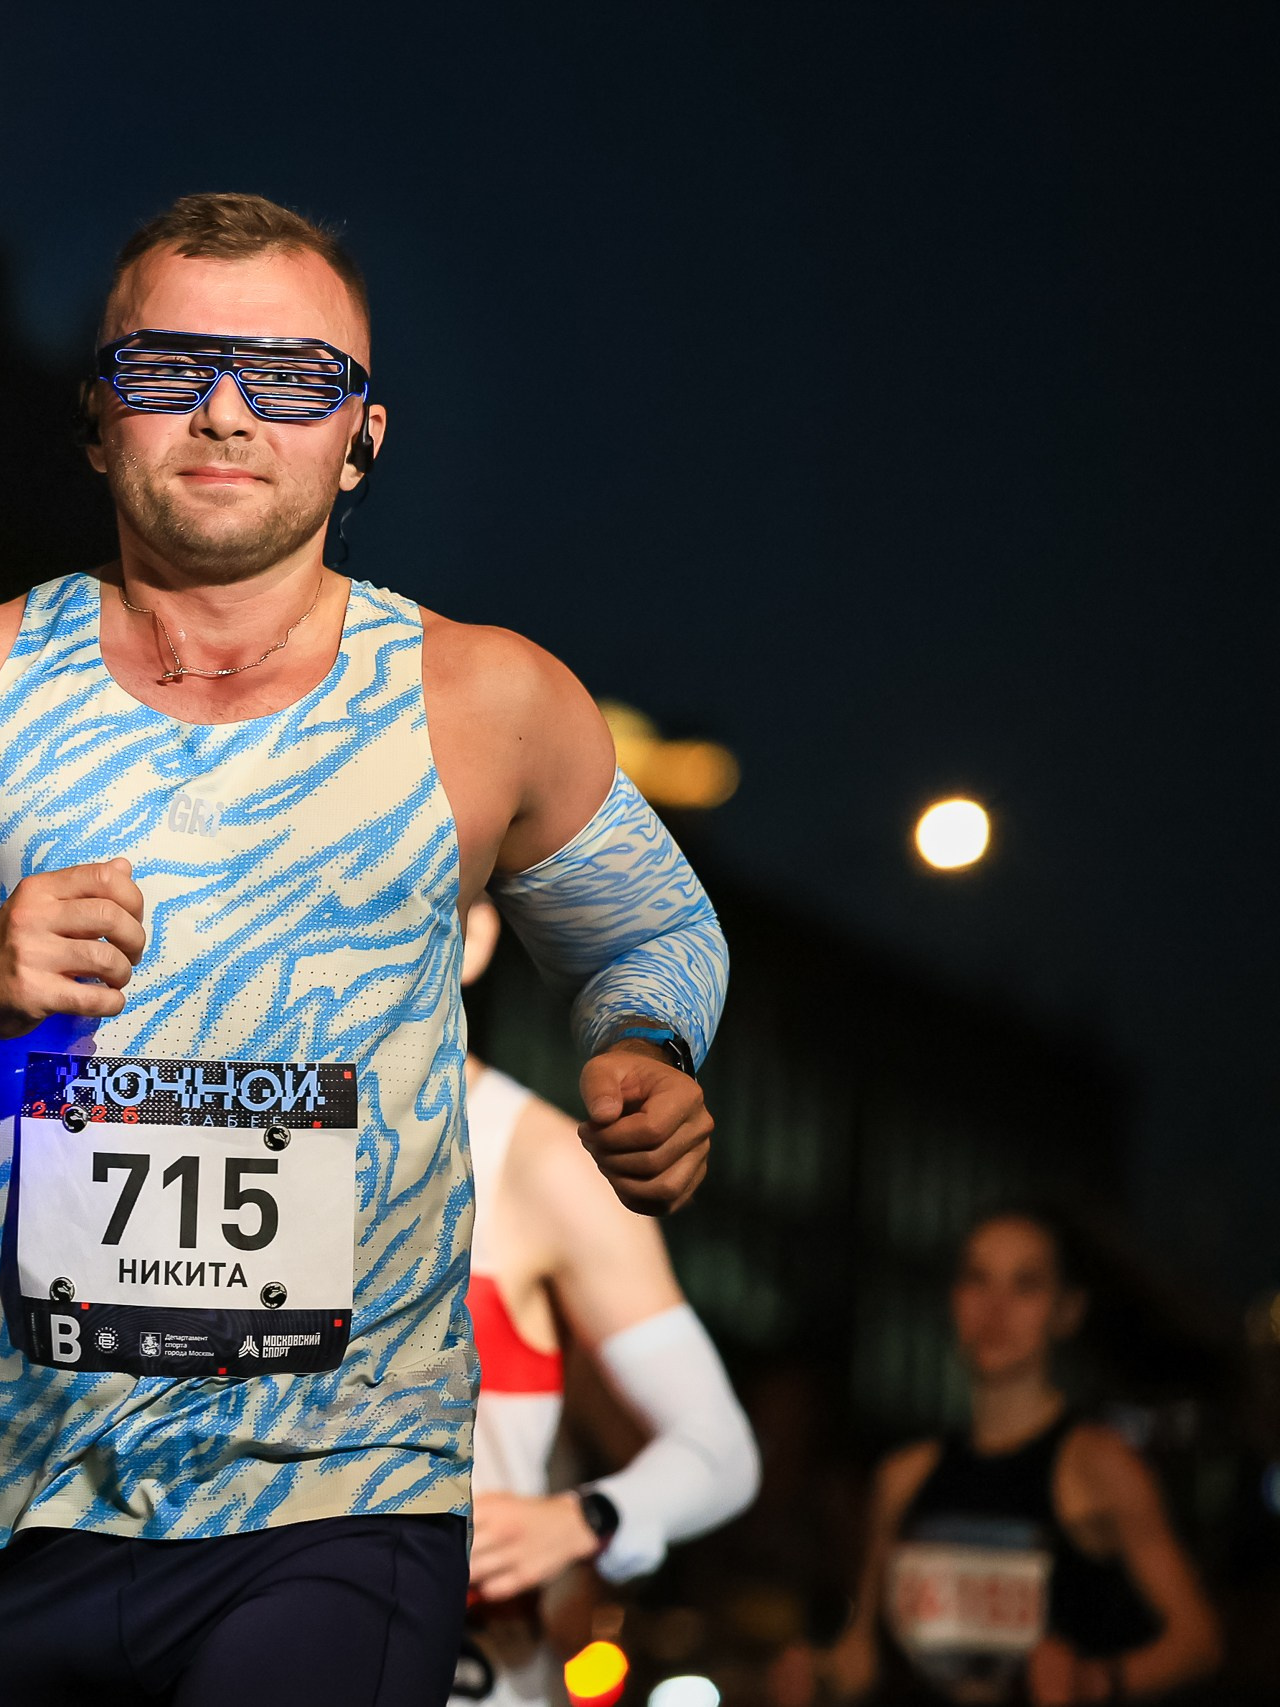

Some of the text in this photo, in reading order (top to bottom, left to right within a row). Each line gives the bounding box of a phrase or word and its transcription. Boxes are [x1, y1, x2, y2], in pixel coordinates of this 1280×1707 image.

[63, 1061, 326, 1112] НОЧНОЙ
[32, 1101, 139, 1124] 226
[92, 1152, 279, 1251] 715
[119, 1258, 248, 1288] НИКИТА
[164, 1342, 188, 1350] спорта
[262, 1332, 321, 1347] МОСКОВСКИЙ
[262, 1346, 291, 1359] СПОРТ
